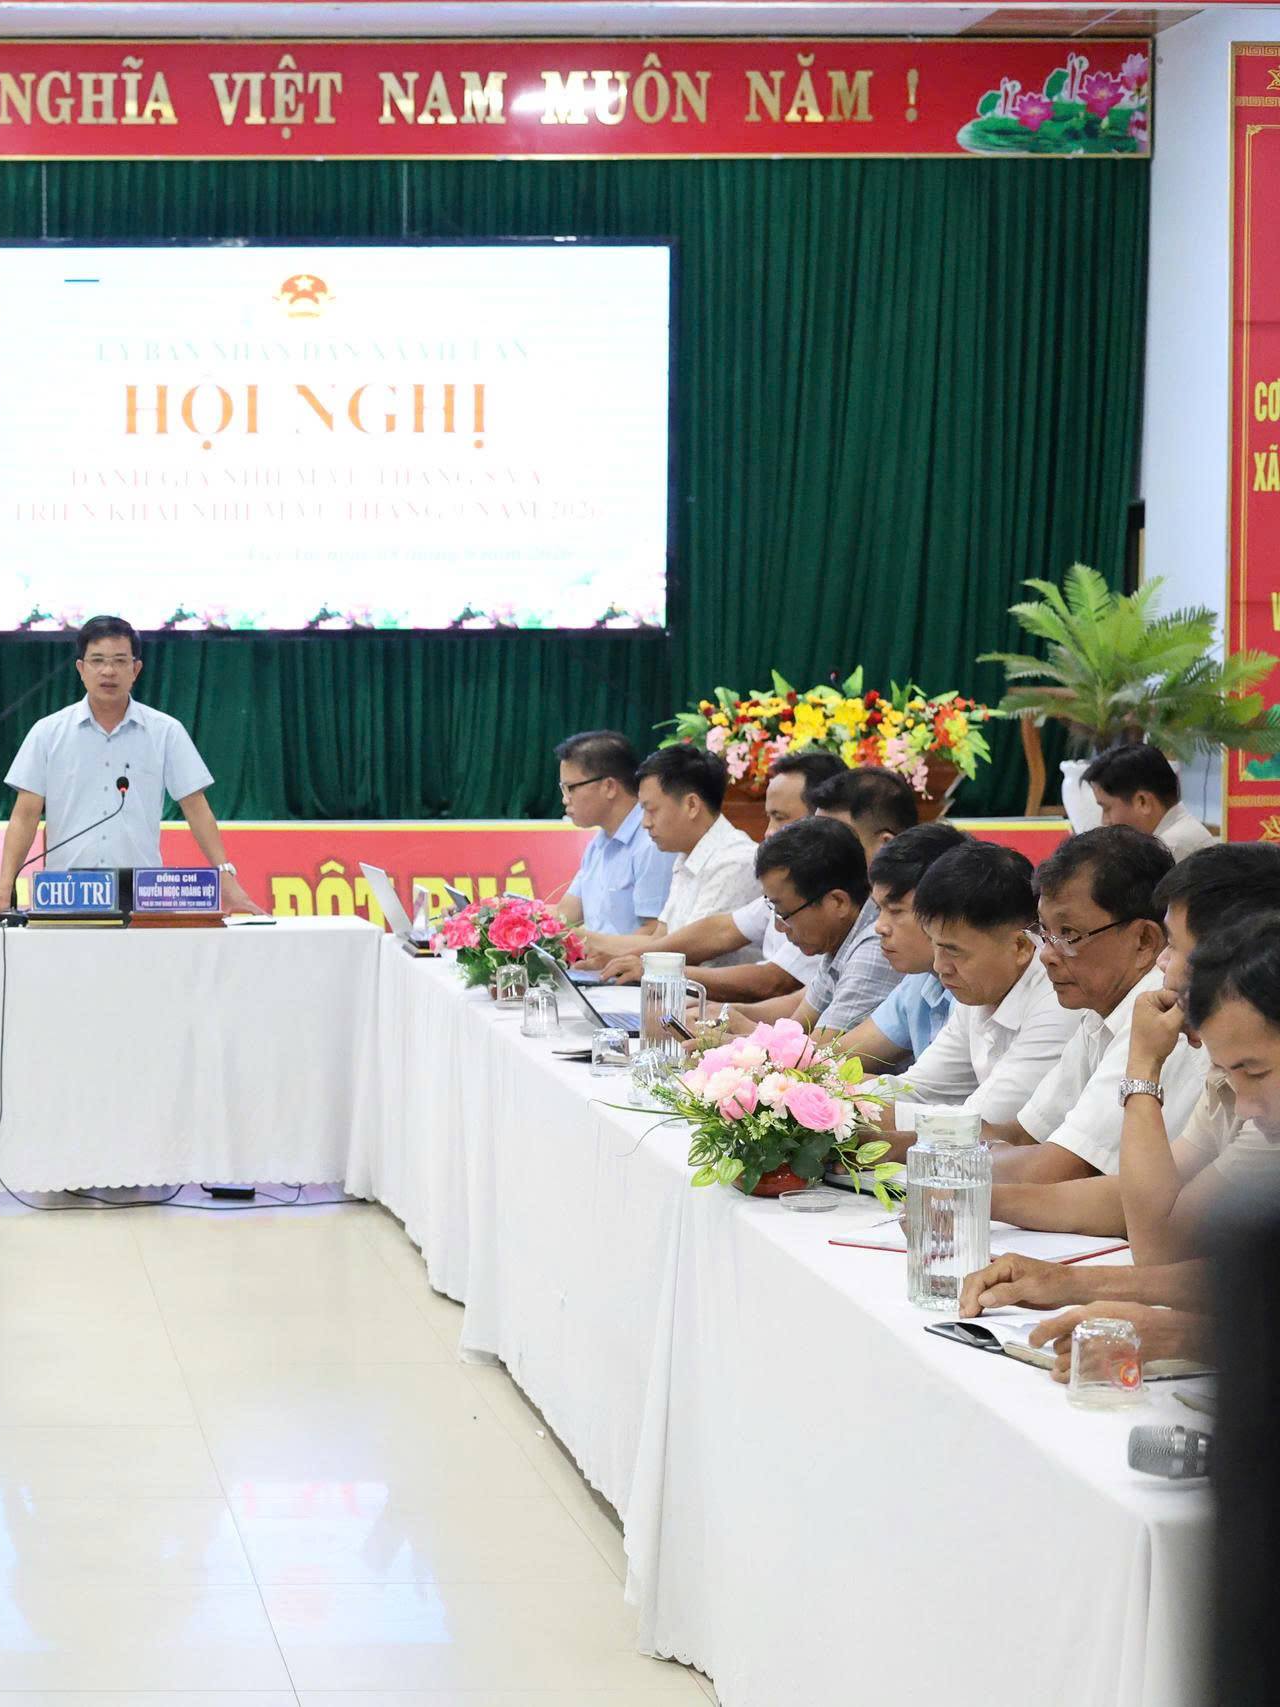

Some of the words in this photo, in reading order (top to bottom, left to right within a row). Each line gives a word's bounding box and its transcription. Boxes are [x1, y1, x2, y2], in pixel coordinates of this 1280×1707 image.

[209, 54, 342, 139] VIỆT
[378, 71, 507, 125] NAM
[540, 53, 711, 125] MUÔN
[745, 53, 873, 123] NĂM
[905, 68, 919, 122] !
[125, 373, 258, 450] HỘI
[295, 383, 486, 449] NGHỊ
[37, 875, 75, 905] CHỦ
[80, 875, 111, 905] TRÌ
